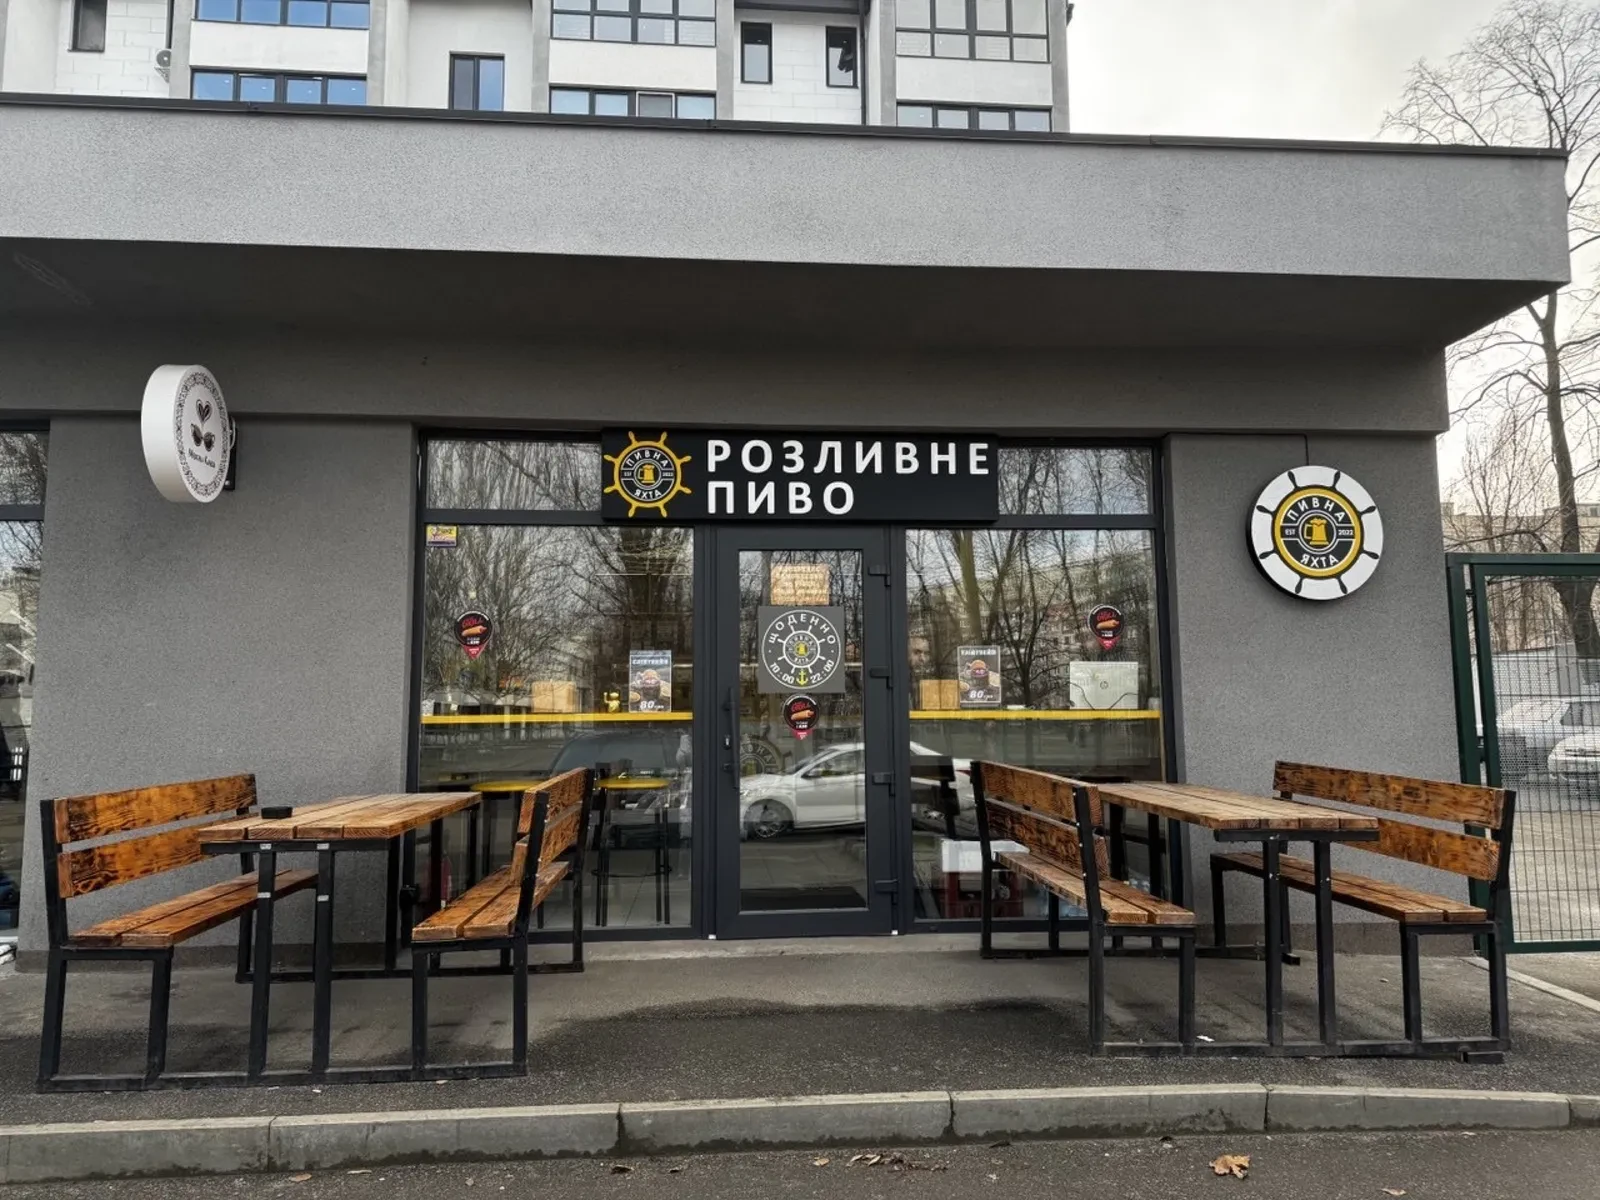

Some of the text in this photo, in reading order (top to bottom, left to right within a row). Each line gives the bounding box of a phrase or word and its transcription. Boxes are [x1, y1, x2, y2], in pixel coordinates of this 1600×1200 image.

[626, 450, 668, 467] ПИВНА
[707, 439, 989, 475] РОЗЛИВНЕ
[634, 489, 662, 499] ЯХТА
[707, 481, 854, 514] ПИВО
[1287, 497, 1346, 522] ПИВНА
[1284, 528, 1354, 536] EST 2022
[1300, 554, 1339, 568] ЯХТА
[768, 613, 836, 645] ЩОДЕННО
[769, 660, 835, 684] 10:00 22:00
[969, 689, 984, 698] 80
[639, 700, 655, 709] 80
